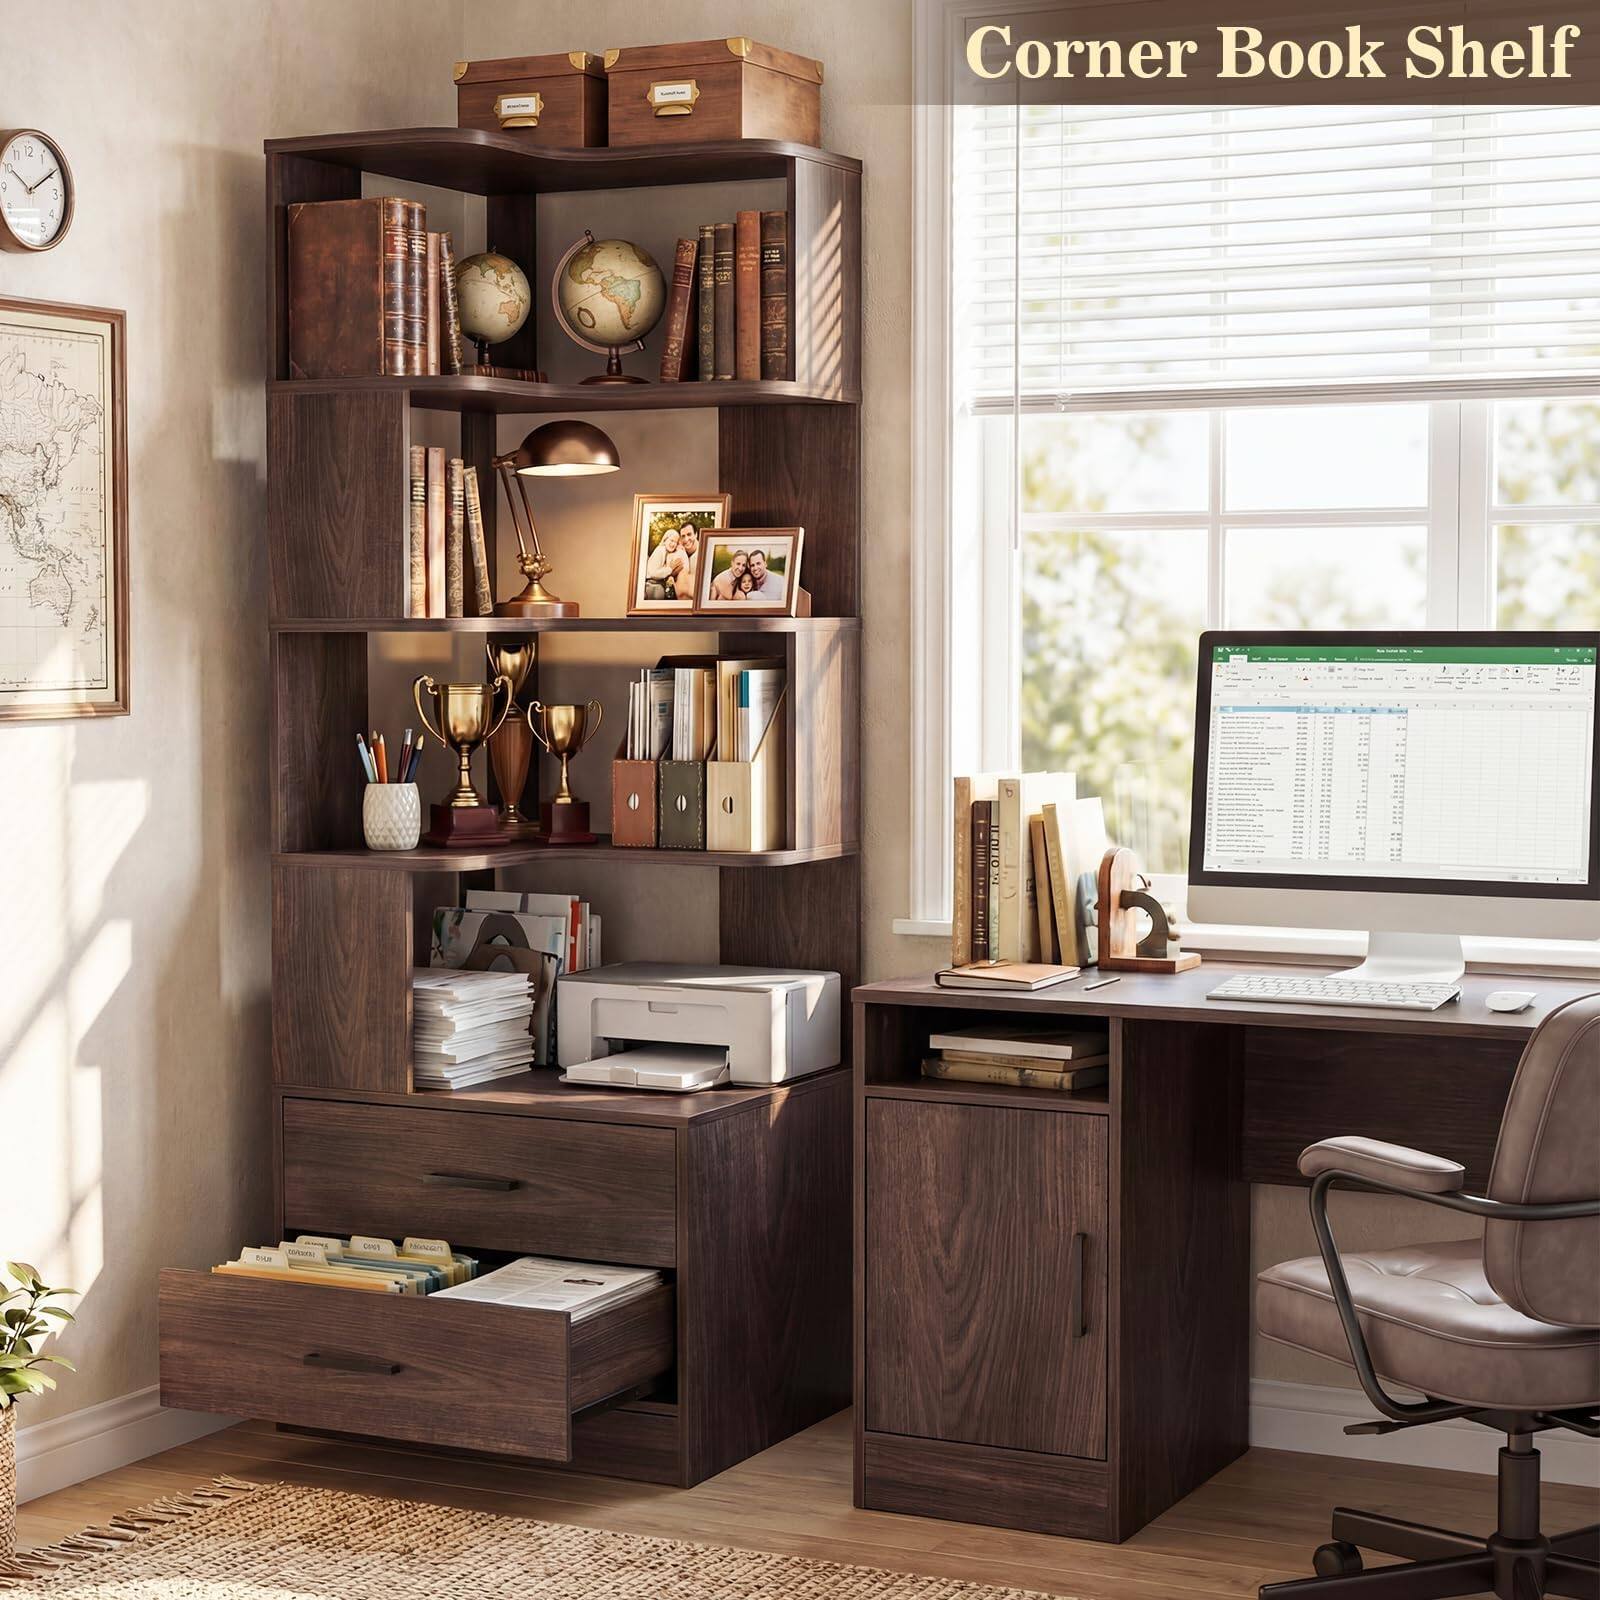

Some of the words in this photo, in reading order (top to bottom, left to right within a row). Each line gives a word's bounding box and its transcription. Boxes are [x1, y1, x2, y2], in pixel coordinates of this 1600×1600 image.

[13, 150, 20, 160] 11
[24, 145, 33, 157] 12
[4, 163, 13, 174] 10
[1, 181, 7, 192] 9
[53, 189, 58, 200] 3
[49, 209, 54, 219] 4
[41, 223, 46, 233] 5
